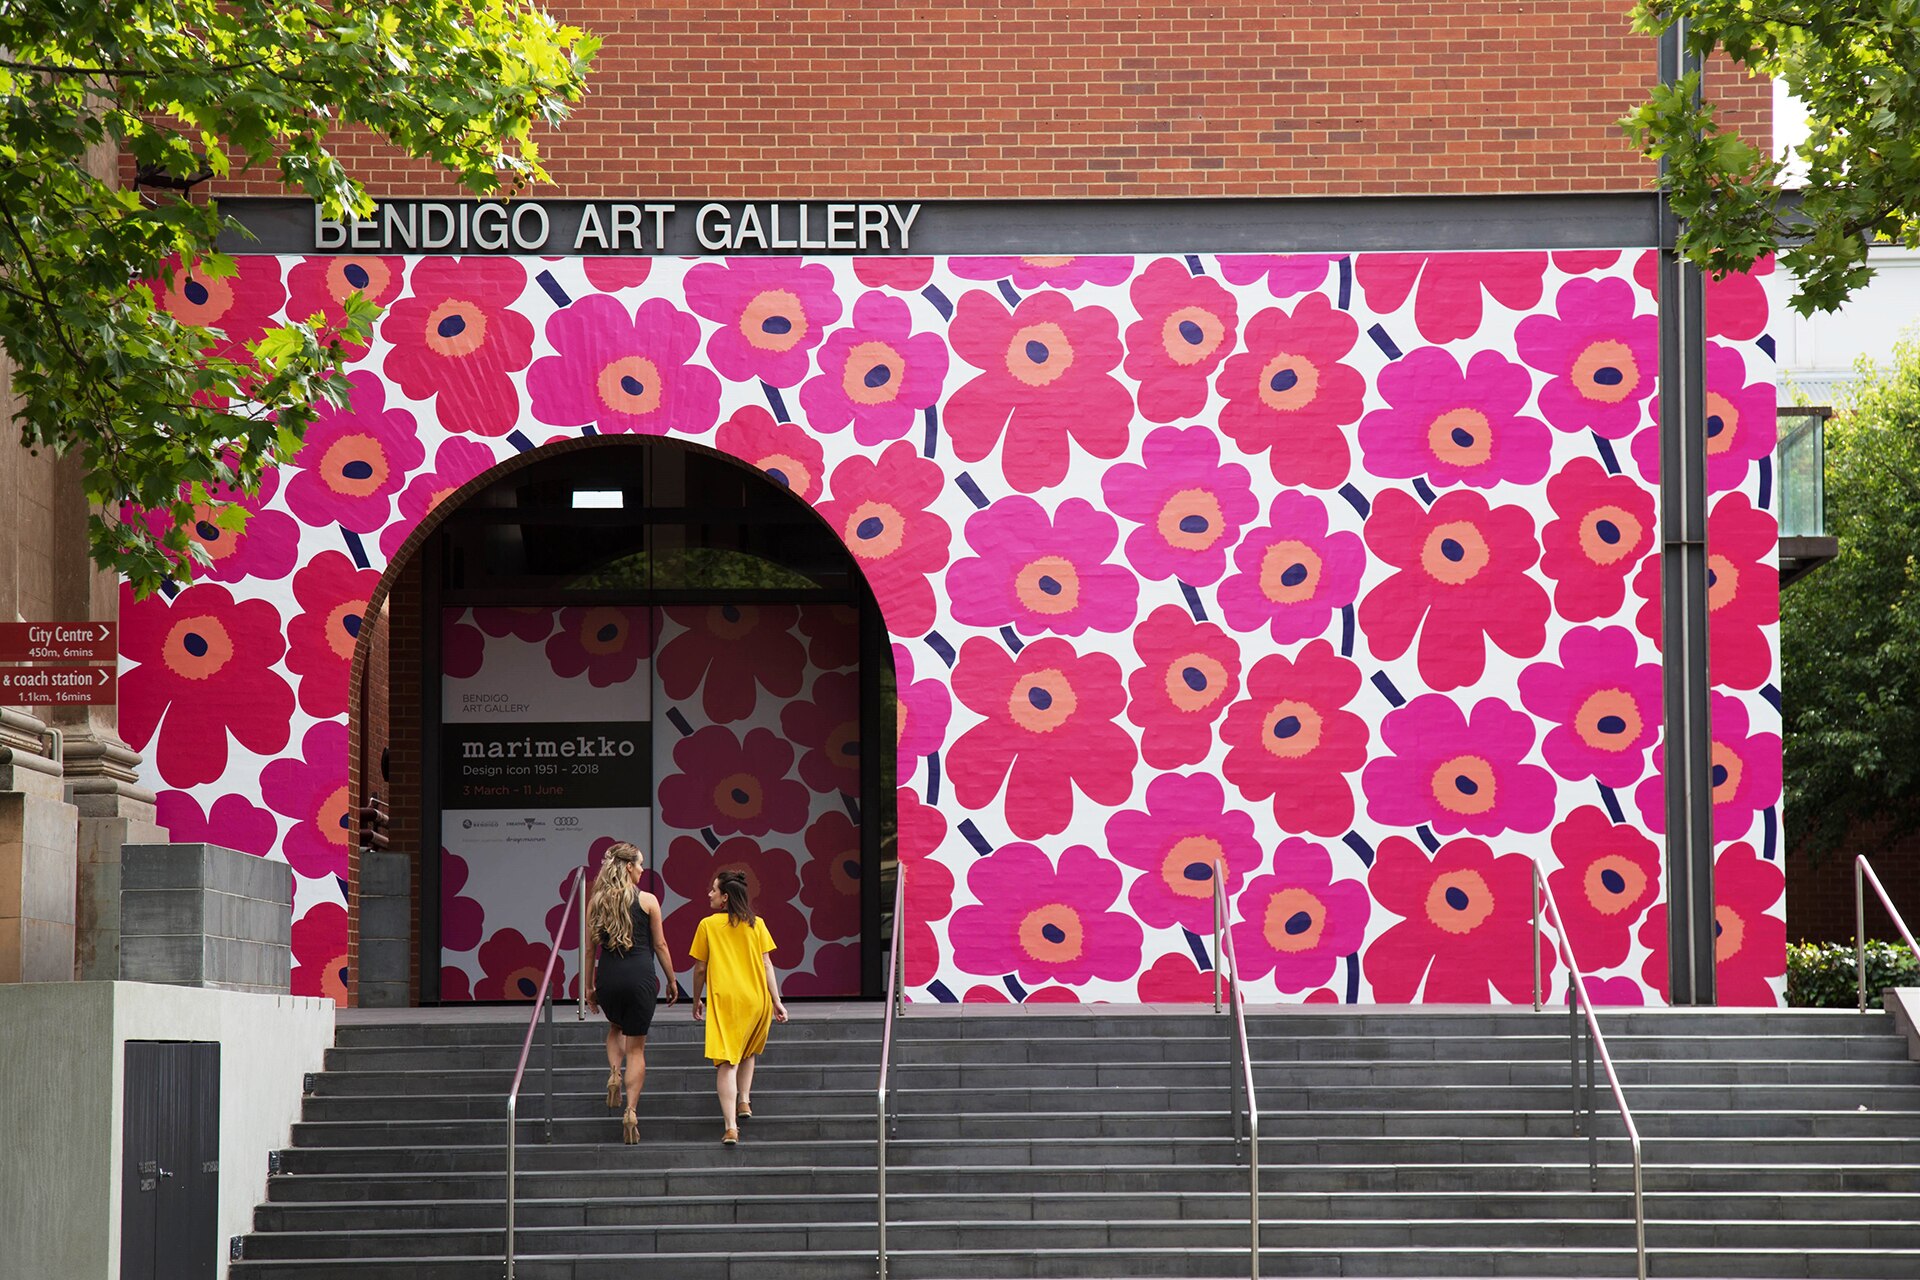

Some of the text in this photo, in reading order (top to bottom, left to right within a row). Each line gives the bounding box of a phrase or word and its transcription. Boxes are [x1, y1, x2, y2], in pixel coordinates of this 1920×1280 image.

[315, 203, 921, 249] BENDIGO ART GALLERY
[28, 626, 94, 647] City Centre
[28, 647, 94, 658] 450m, 6mins
[2, 670, 93, 687] & coach station
[18, 691, 92, 702] 1.1km, 16mins
[462, 694, 509, 703] BENDIGO
[462, 704, 530, 713] ART GALLERY
[462, 736, 635, 758] marimekko
[463, 765, 503, 777] Design
[506, 765, 531, 775] icon
[534, 764, 558, 774] 1951
[571, 763, 599, 774] 2018
[463, 785, 470, 796] 3
[474, 785, 510, 796] March
[523, 785, 531, 795] 11
[535, 785, 564, 795] June
